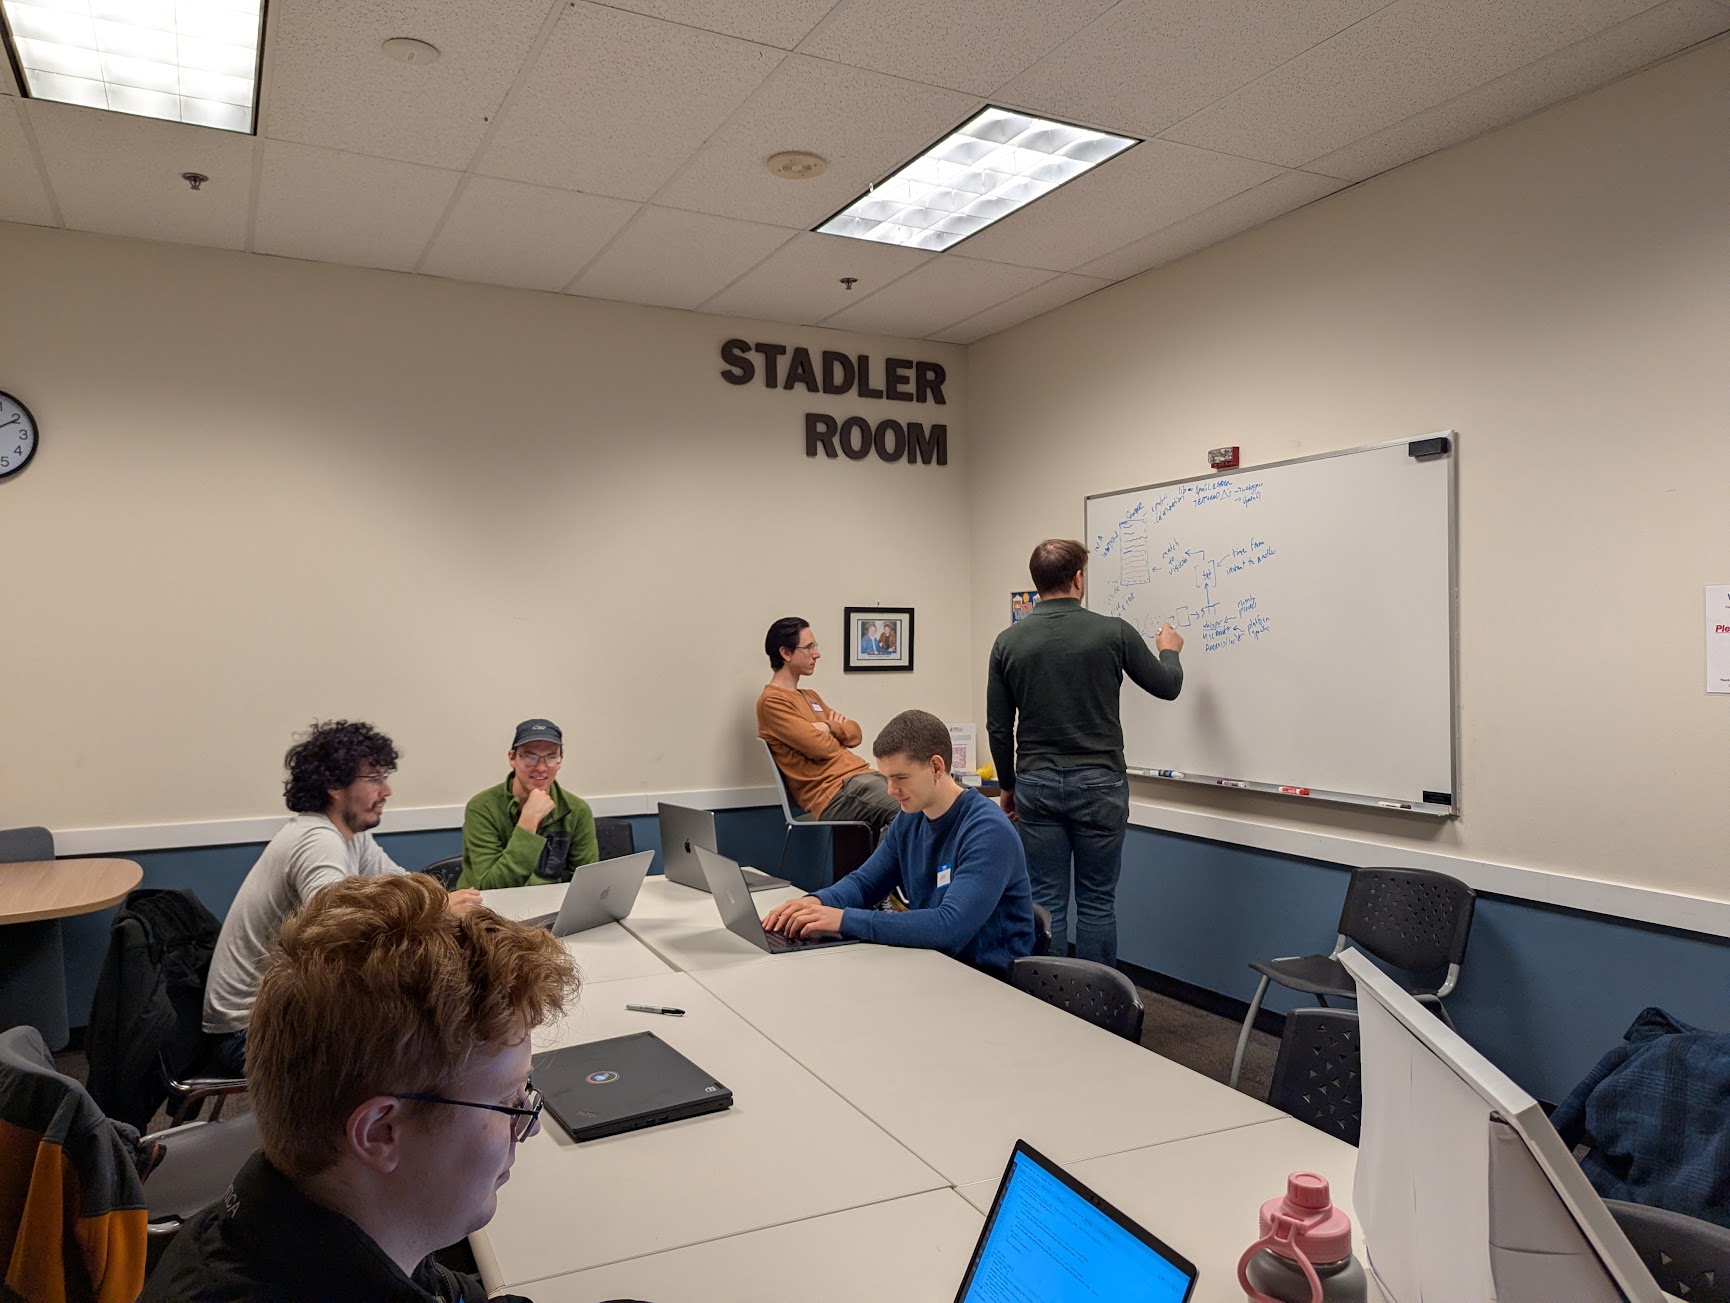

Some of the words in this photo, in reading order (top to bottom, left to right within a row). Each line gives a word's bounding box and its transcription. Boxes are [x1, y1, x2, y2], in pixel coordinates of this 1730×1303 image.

[721, 338, 946, 405] STADLER
[11, 413, 21, 424] 2
[19, 429, 28, 440] 3
[805, 412, 948, 466] ROOM
[13, 445, 23, 456] 4
[0, 456, 10, 467] 5
